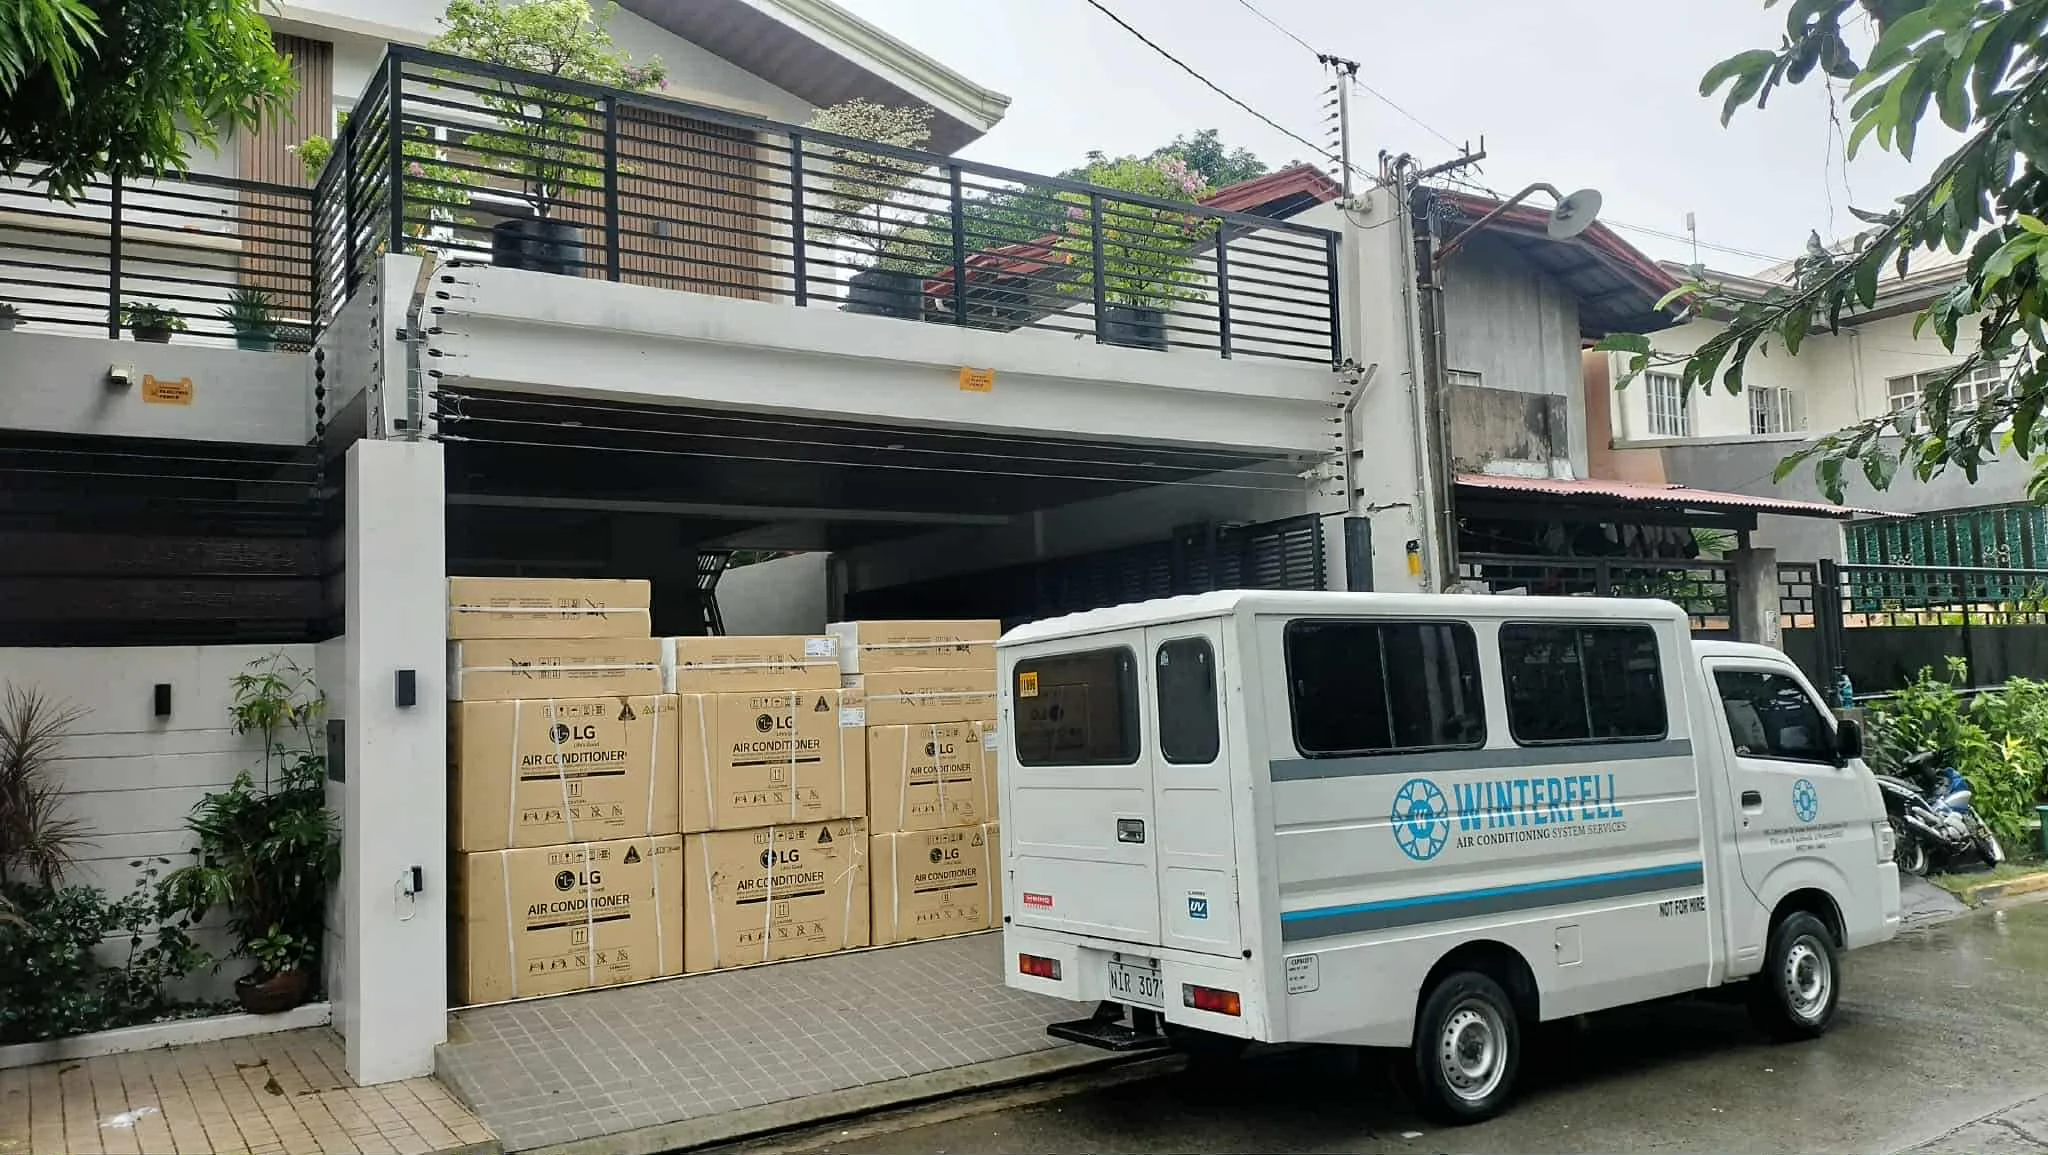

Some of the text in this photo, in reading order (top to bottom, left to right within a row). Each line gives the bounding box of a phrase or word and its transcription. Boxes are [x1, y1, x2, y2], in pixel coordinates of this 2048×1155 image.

[774, 715, 793, 730] LG
[573, 725, 596, 740] LG
[733, 739, 820, 753] AIR CONDITIONER
[939, 743, 954, 754] LG
[522, 750, 625, 766] AIR CONDITIONER
[910, 763, 971, 776] AIR CONDITIONER
[1453, 773, 1624, 832] WINTERFELL
[1456, 821, 1628, 849] AIR CONDITIONING SYSTEM SERVICES
[780, 849, 800, 863] LG
[944, 848, 960, 860] LG
[579, 870, 601, 886] LG
[737, 871, 824, 891] AIR CONDITIONER
[915, 867, 977, 883] AIR CONDITIONER
[528, 894, 630, 916] AIR CONDITIONER
[1190, 901, 1206, 912] UV
[1659, 896, 1705, 917] NOT FOR HIRE
[1110, 970, 1131, 992] NIR
